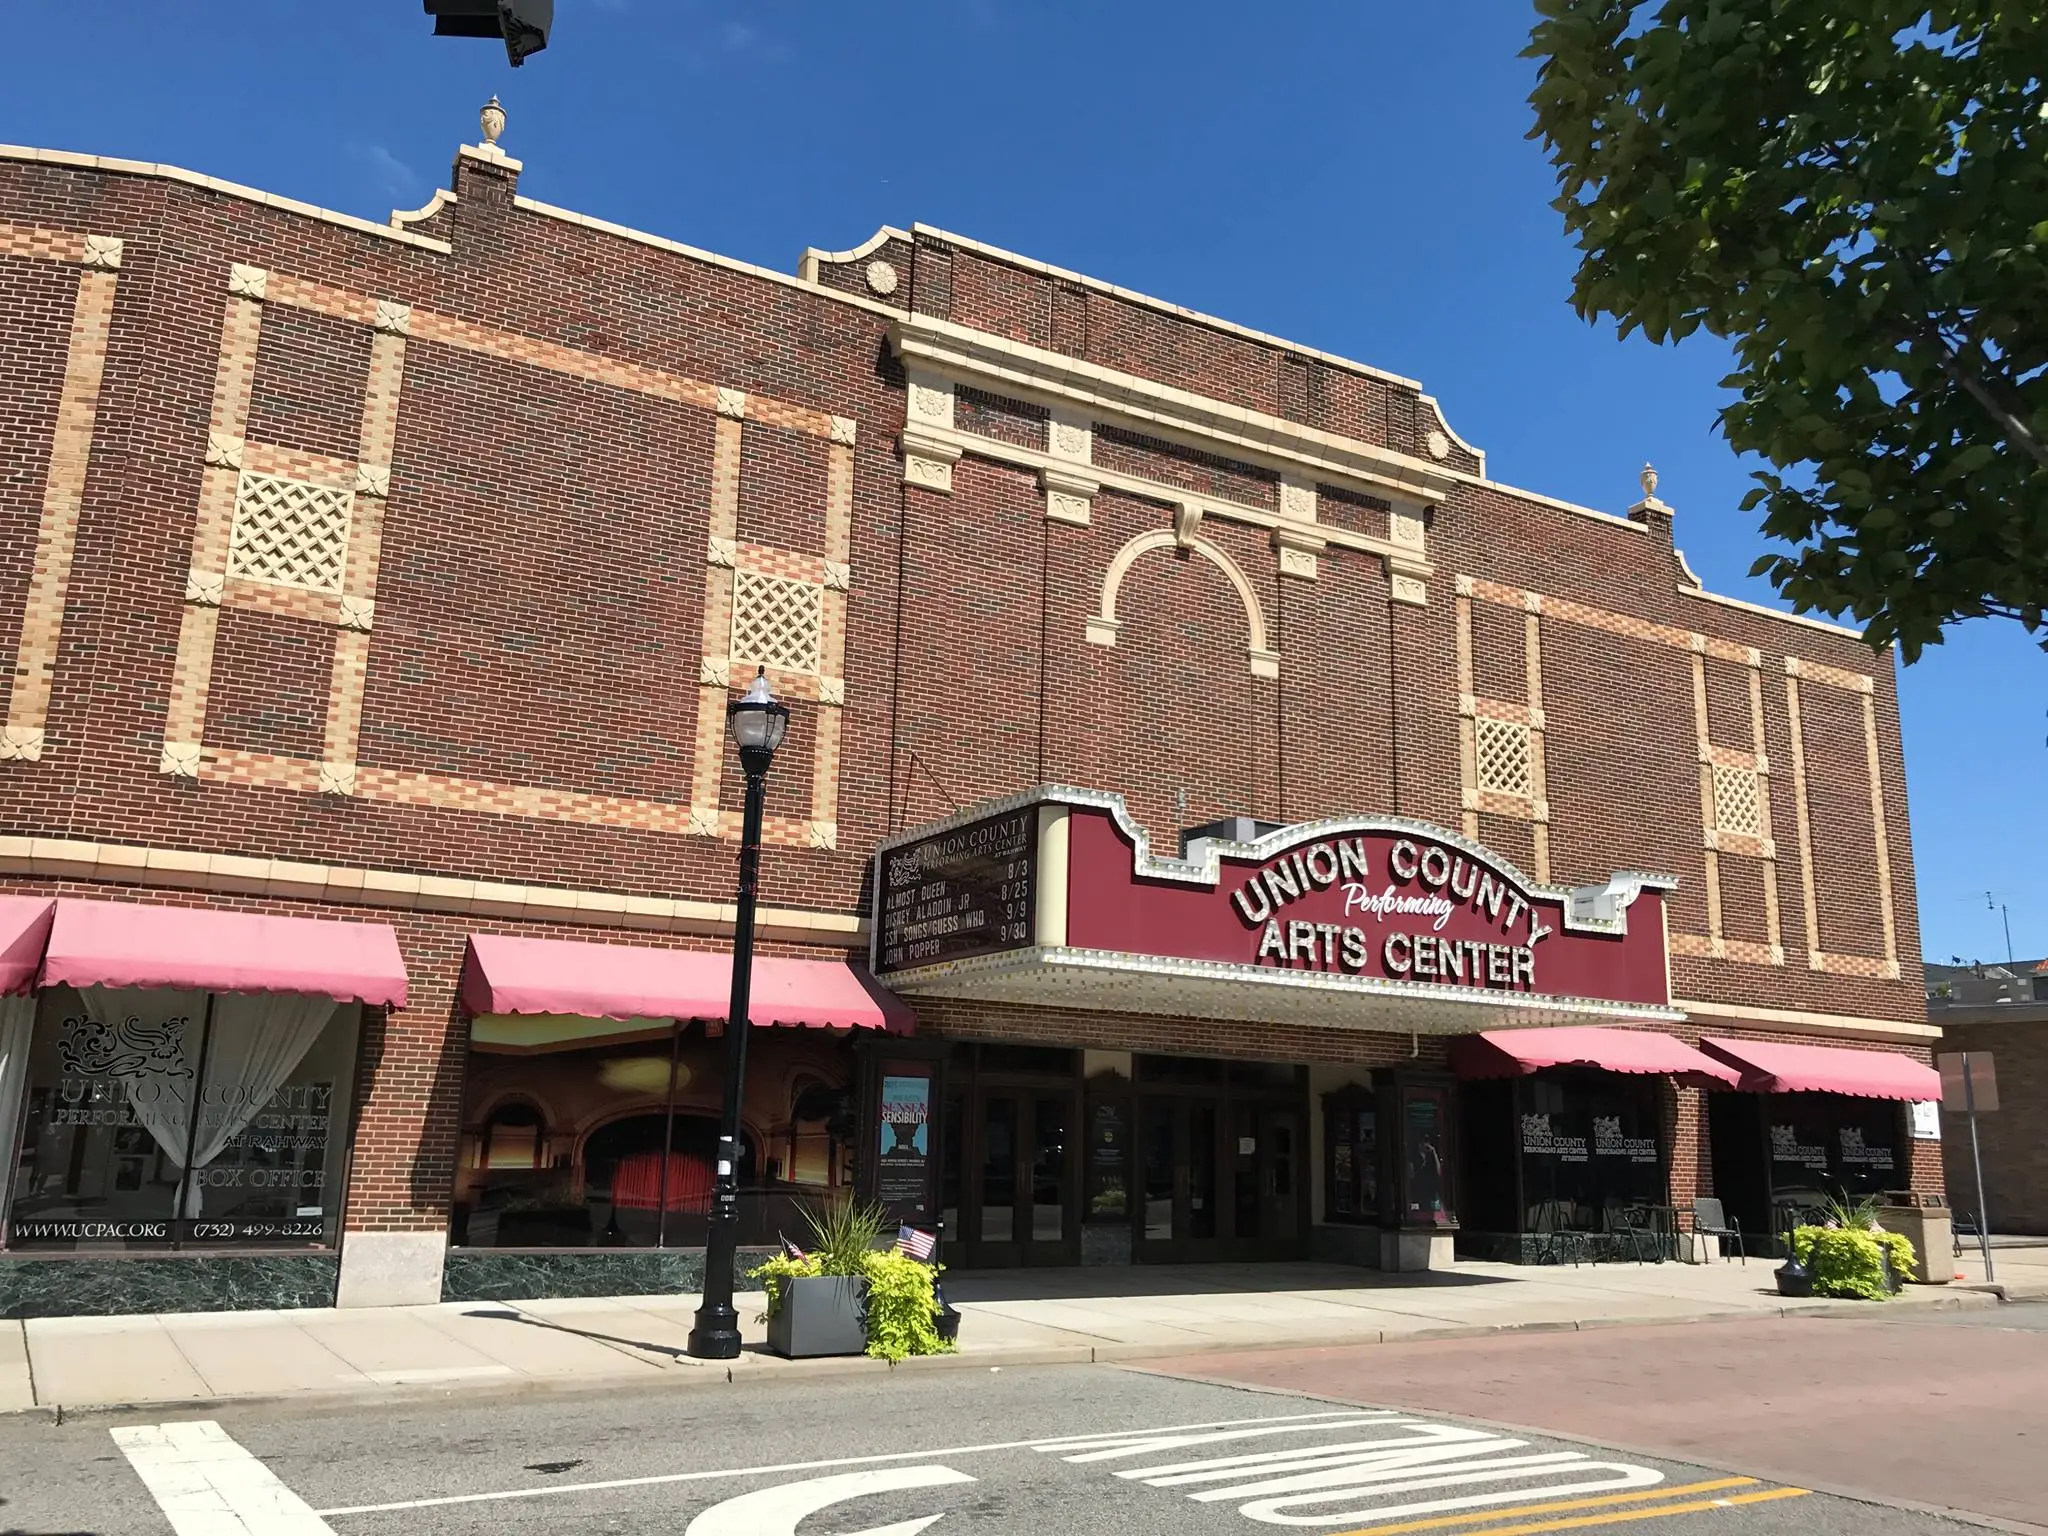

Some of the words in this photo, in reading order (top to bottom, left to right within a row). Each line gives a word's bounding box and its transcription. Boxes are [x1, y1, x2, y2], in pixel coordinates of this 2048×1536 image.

[922, 851, 970, 871] PERFORMING
[973, 843, 992, 857] ARTS
[995, 832, 1027, 850] CENTER
[924, 836, 965, 860] UNION
[969, 815, 1028, 846] COUNTY
[886, 889, 915, 909] ALMOST
[921, 881, 945, 900] QUEEN
[1007, 861, 1028, 878] 8/3
[1234, 837, 1369, 922] UNION
[1391, 839, 1553, 948] COUNTY
[885, 909, 910, 928] DISNEY
[916, 899, 951, 920] ALADDIN
[958, 893, 969, 910] JR
[1001, 881, 1028, 900] 8/25
[1340, 883, 1455, 931] Performing
[885, 930, 898, 945] CSN
[904, 915, 959, 943] SONGS/GUESS
[966, 910, 984, 928] WHO
[1006, 902, 1026, 919] 9/9
[884, 947, 903, 965] JOHN
[909, 940, 940, 958] POPPER
[1000, 922, 1026, 942] 9/30
[1258, 917, 1367, 969] ARTS
[1384, 932, 1535, 985] CENTER
[61, 1079, 190, 1104] UNION
[200, 1082, 332, 1109] COUNTY
[55, 1108, 187, 1127] PERFORMING
[198, 1110, 248, 1127] ARTS
[255, 1114, 330, 1130] CENTER
[882, 1111, 928, 1124] SENSIBILITY
[223, 1136, 247, 1148] AT
[248, 1135, 329, 1149] RAHWAY
[1523, 1136, 1552, 1147] UNION
[1553, 1138, 1586, 1148] COUNTY
[1596, 1138, 1622, 1148] UNION
[1624, 1139, 1655, 1148] COUNTY
[1774, 1145, 1796, 1155] UNION
[1798, 1146, 1825, 1155] COUNTY
[1842, 1147, 1864, 1157] UNION
[1865, 1148, 1892, 1157] COUNTY
[197, 1169, 243, 1188] BOX
[249, 1169, 326, 1189] OFFICE
[15, 1223, 166, 1237] WWW.UCPAC.ORG
[194, 1224, 235, 1238] (732)
[242, 1224, 322, 1237] 499-8226
[1030, 1417, 1666, 1526] ONLY
